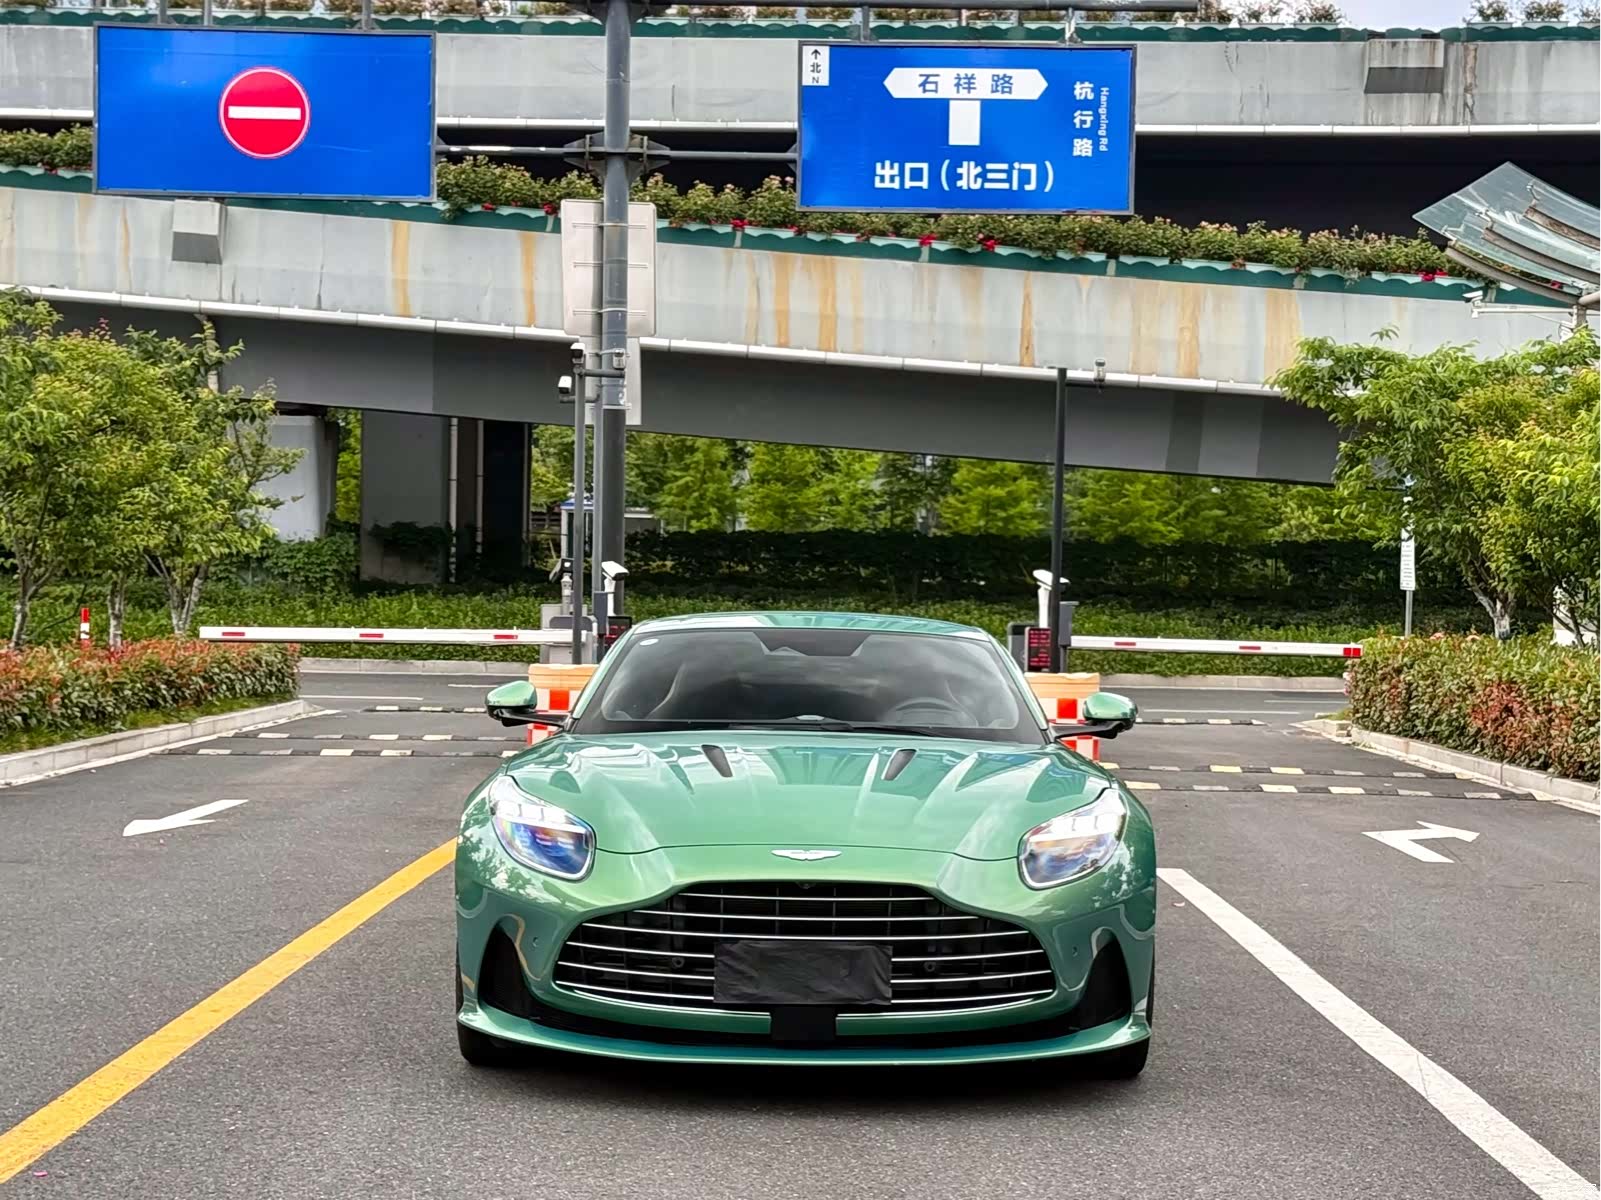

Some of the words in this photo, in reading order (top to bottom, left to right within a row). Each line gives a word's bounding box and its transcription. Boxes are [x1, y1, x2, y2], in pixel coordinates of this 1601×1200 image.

[810, 61, 822, 74] 北
[811, 76, 820, 84] N
[917, 73, 1014, 95] 石祥路
[1072, 81, 1095, 157] 杭行路
[1098, 87, 1110, 136] Hangxing
[1099, 137, 1109, 152] Rd
